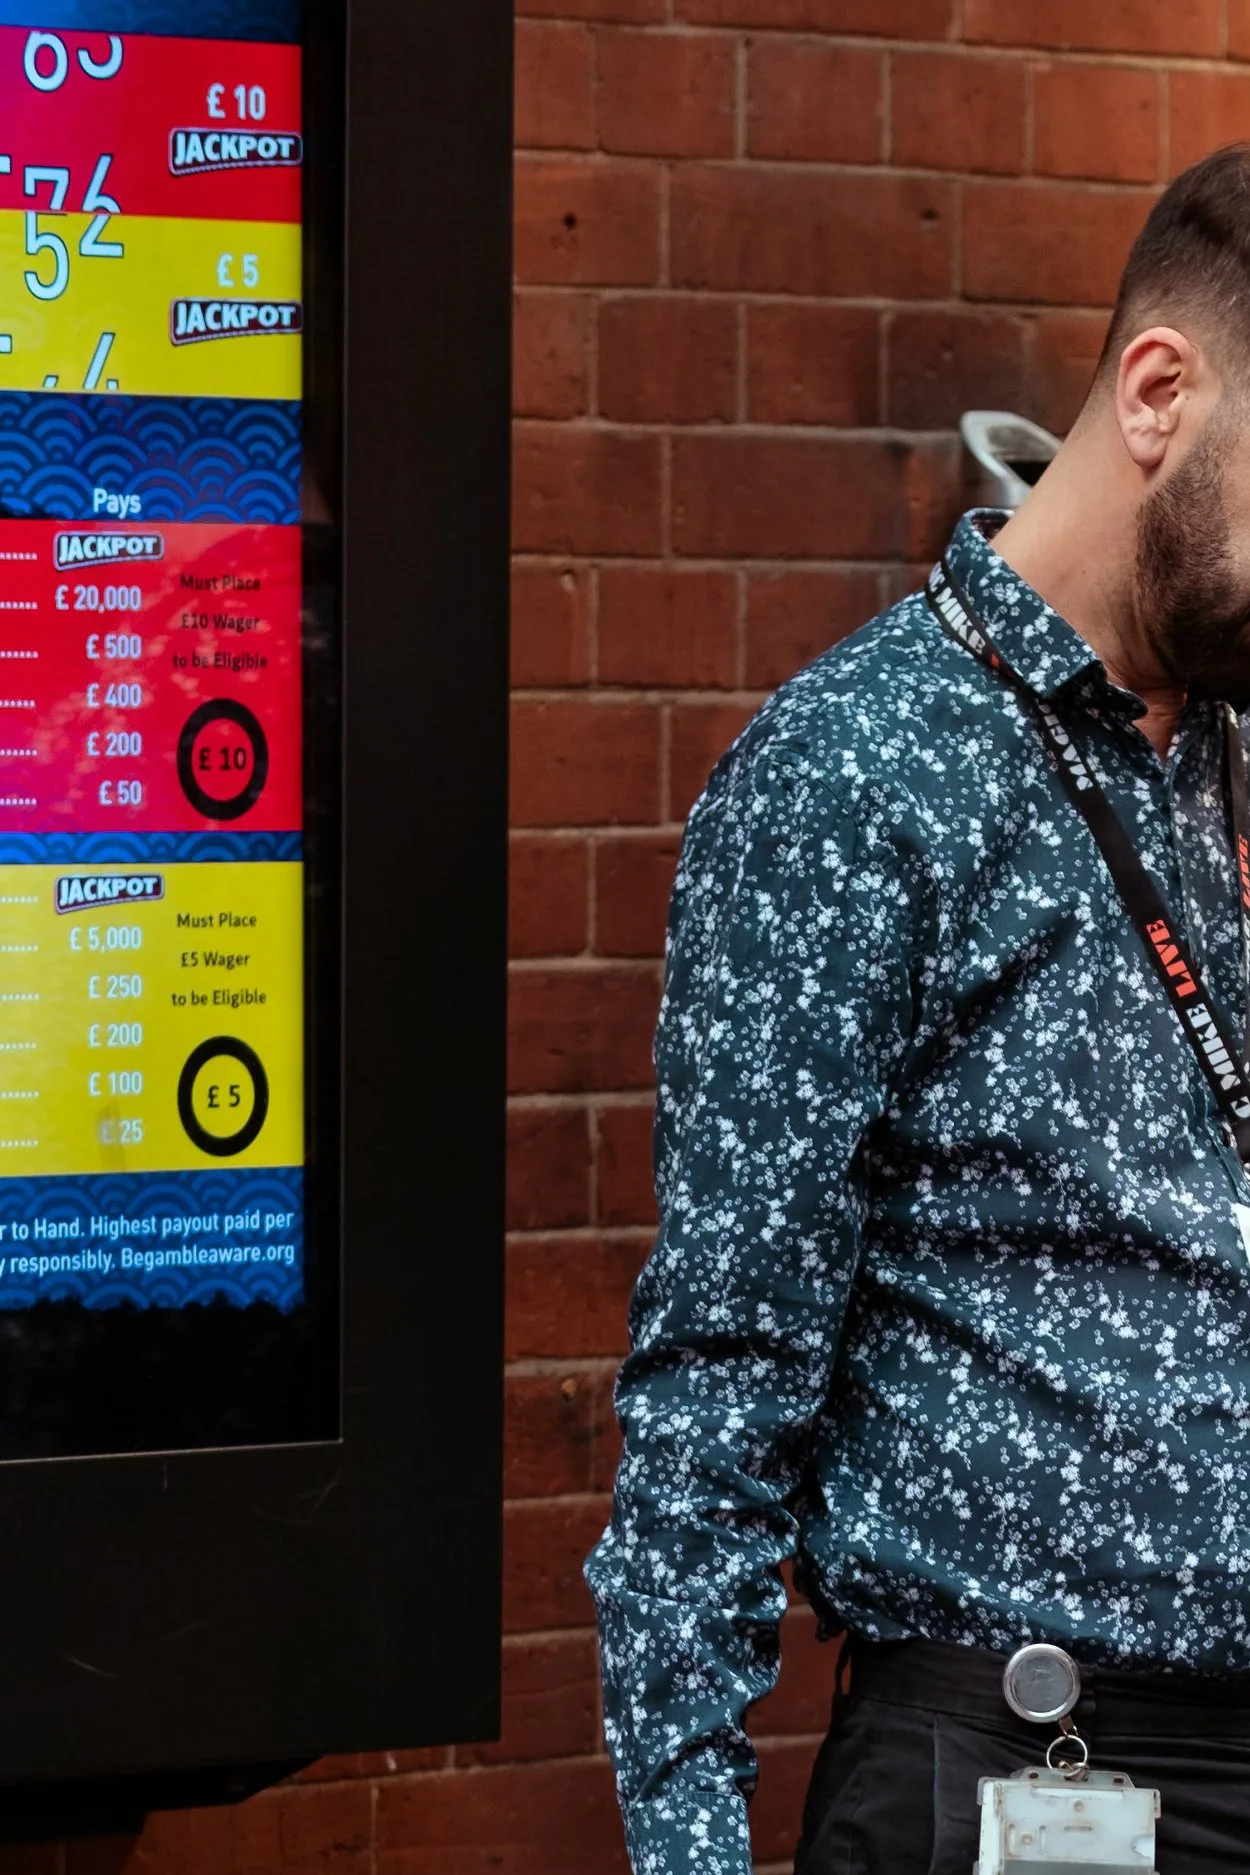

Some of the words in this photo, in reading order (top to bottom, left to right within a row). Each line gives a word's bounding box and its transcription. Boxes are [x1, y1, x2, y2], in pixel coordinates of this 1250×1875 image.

[206, 83, 226, 119] £
[233, 85, 267, 120] 10
[173, 132, 296, 166] JACKPOT
[216, 253, 235, 288] £
[242, 253, 260, 288] 5
[176, 303, 296, 336] JACKPOT
[93, 488, 142, 519] Pays
[59, 535, 158, 564] JACKPOT
[180, 575, 218, 591] Must
[221, 575, 261, 591] Place
[55, 585, 70, 611] £
[74, 586, 142, 614] 20,000
[181, 613, 209, 630] £10
[213, 614, 261, 634] Wager
[934, 587, 986, 654] MIKE
[86, 634, 100, 659] £
[105, 634, 142, 659] 500
[173, 655, 188, 669] to
[191, 654, 209, 669] be
[213, 654, 268, 671] Eligible
[86, 683, 100, 709] £
[105, 684, 142, 709] 400
[86, 732, 100, 757] £
[105, 732, 142, 757] 200
[199, 748, 211, 771] £
[219, 748, 248, 771] 10
[100, 780, 113, 806] £
[118, 780, 142, 806] 50
[60, 876, 158, 906] JACKPOT
[177, 913, 214, 928] Must
[218, 912, 258, 928] Place
[69, 927, 82, 951] £
[88, 926, 143, 952] 5,000
[180, 952, 199, 967] £5
[203, 952, 251, 970] Wager
[1146, 919, 1198, 998] LIVE
[88, 976, 99, 999] £
[106, 974, 143, 998] 250
[172, 992, 187, 1006] to
[190, 991, 209, 1006] be
[212, 990, 267, 1008] Eligible
[88, 1024, 99, 1048] £
[106, 1023, 143, 1046] 200
[1186, 1003, 1241, 1091] MIKE
[88, 1071, 101, 1096] £
[108, 1070, 143, 1095] 100
[207, 1086, 220, 1109] £
[228, 1085, 241, 1108] 5
[119, 1118, 144, 1144] 25
[12, 1221, 29, 1241] to
[34, 1216, 85, 1240] Hand.
[91, 1215, 158, 1240] Highest
[161, 1213, 220, 1239] payout
[224, 1209, 260, 1236] paid
[265, 1212, 295, 1232] per
[10, 1250, 115, 1278] responsibly.
[121, 1244, 295, 1272] Begambleaware.org
